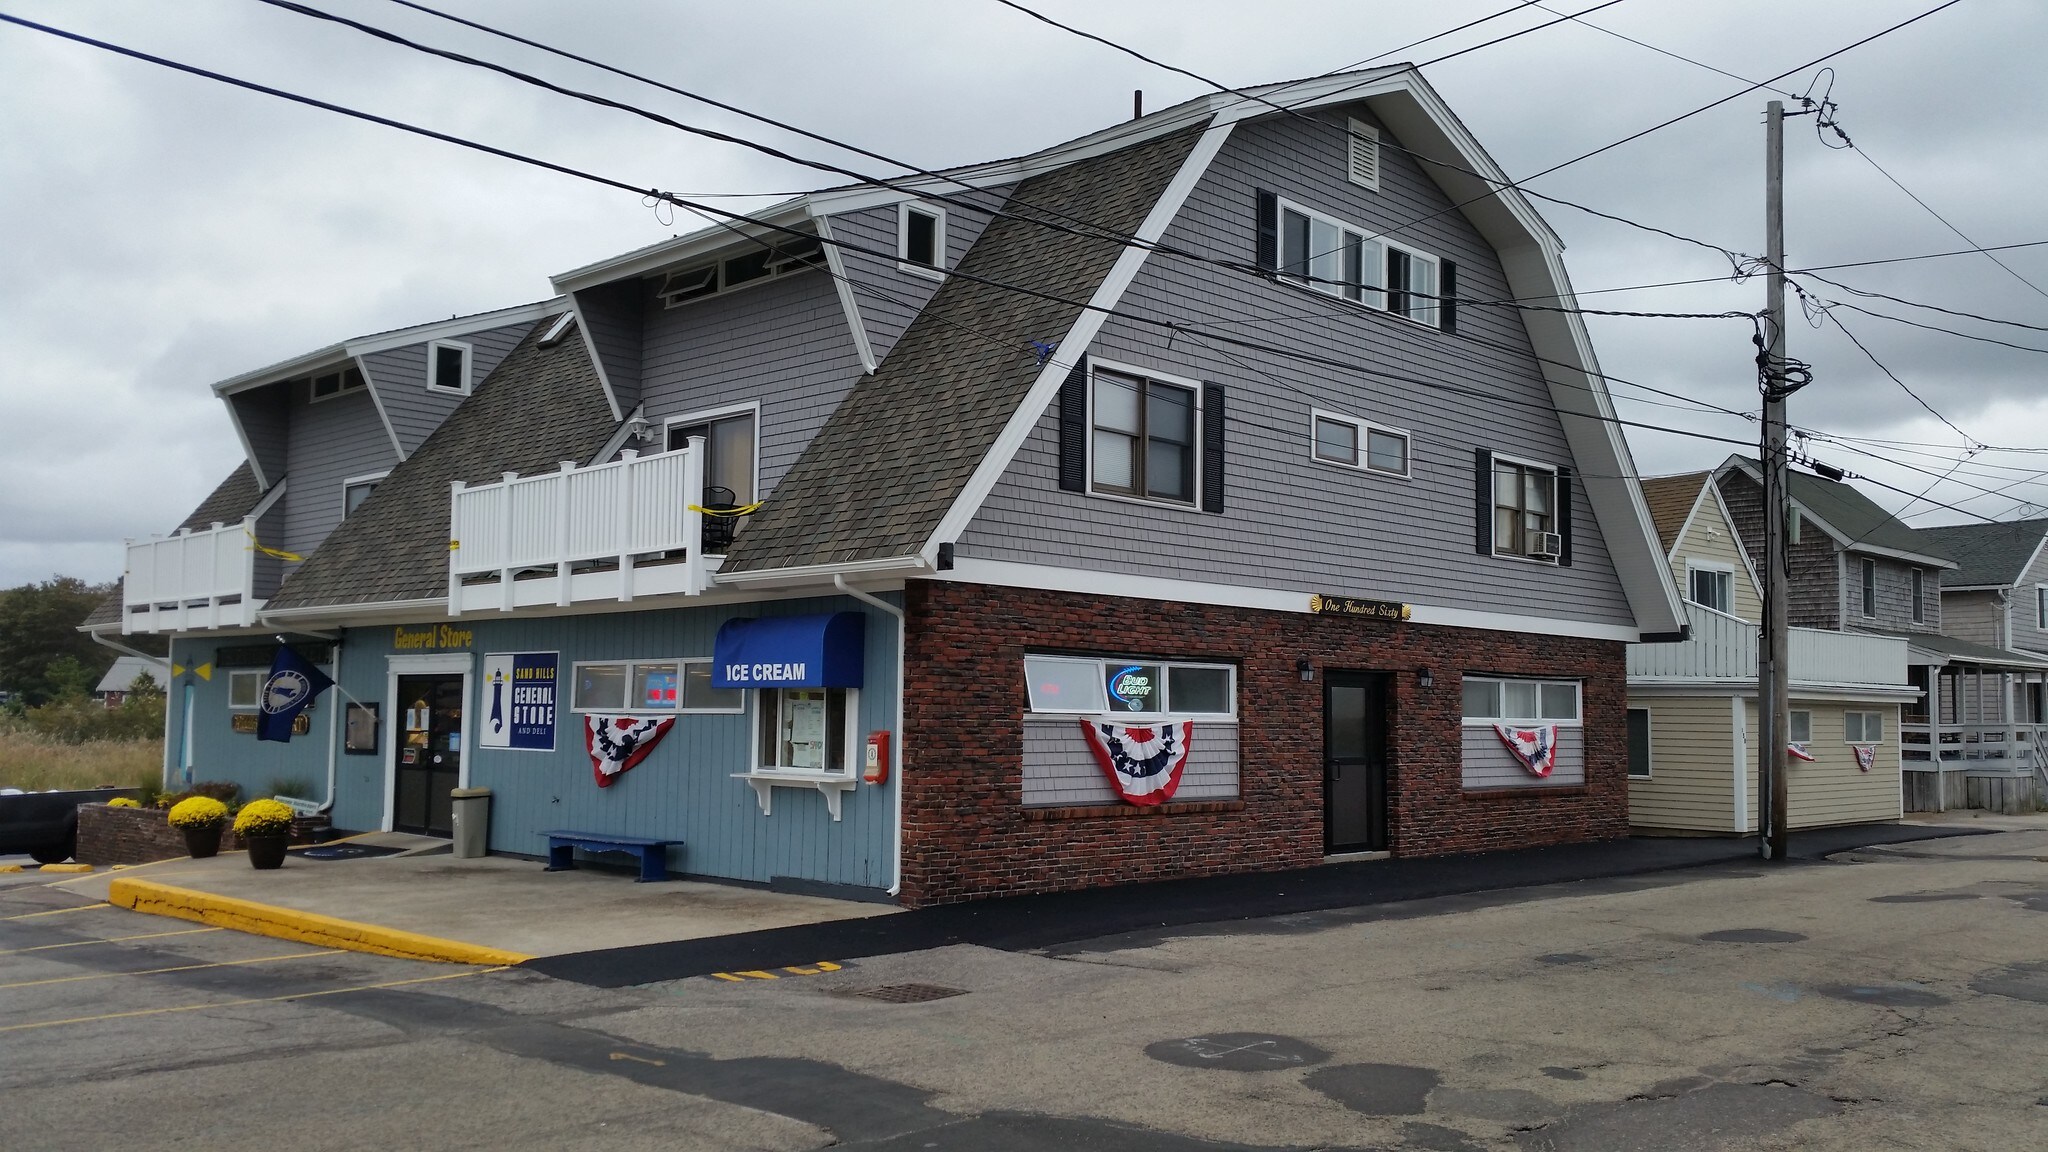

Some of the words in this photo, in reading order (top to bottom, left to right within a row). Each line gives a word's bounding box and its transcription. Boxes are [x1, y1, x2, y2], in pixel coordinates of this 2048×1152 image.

[1324, 598, 1341, 612] One
[1342, 600, 1376, 615] Hundred
[1378, 604, 1399, 619] Sixty
[394, 625, 437, 649] General
[440, 624, 473, 648] Store
[515, 668, 533, 680] SAND
[535, 667, 555, 680] HILLS
[726, 664, 749, 681] ICE
[752, 663, 806, 681] CREAM
[1123, 674, 1149, 686] BUD
[514, 686, 554, 705] GENERAL
[1116, 683, 1152, 695] LIGHT
[513, 705, 553, 725] STORE
[518, 727, 531, 735] AND
[532, 727, 547, 736] DELI
